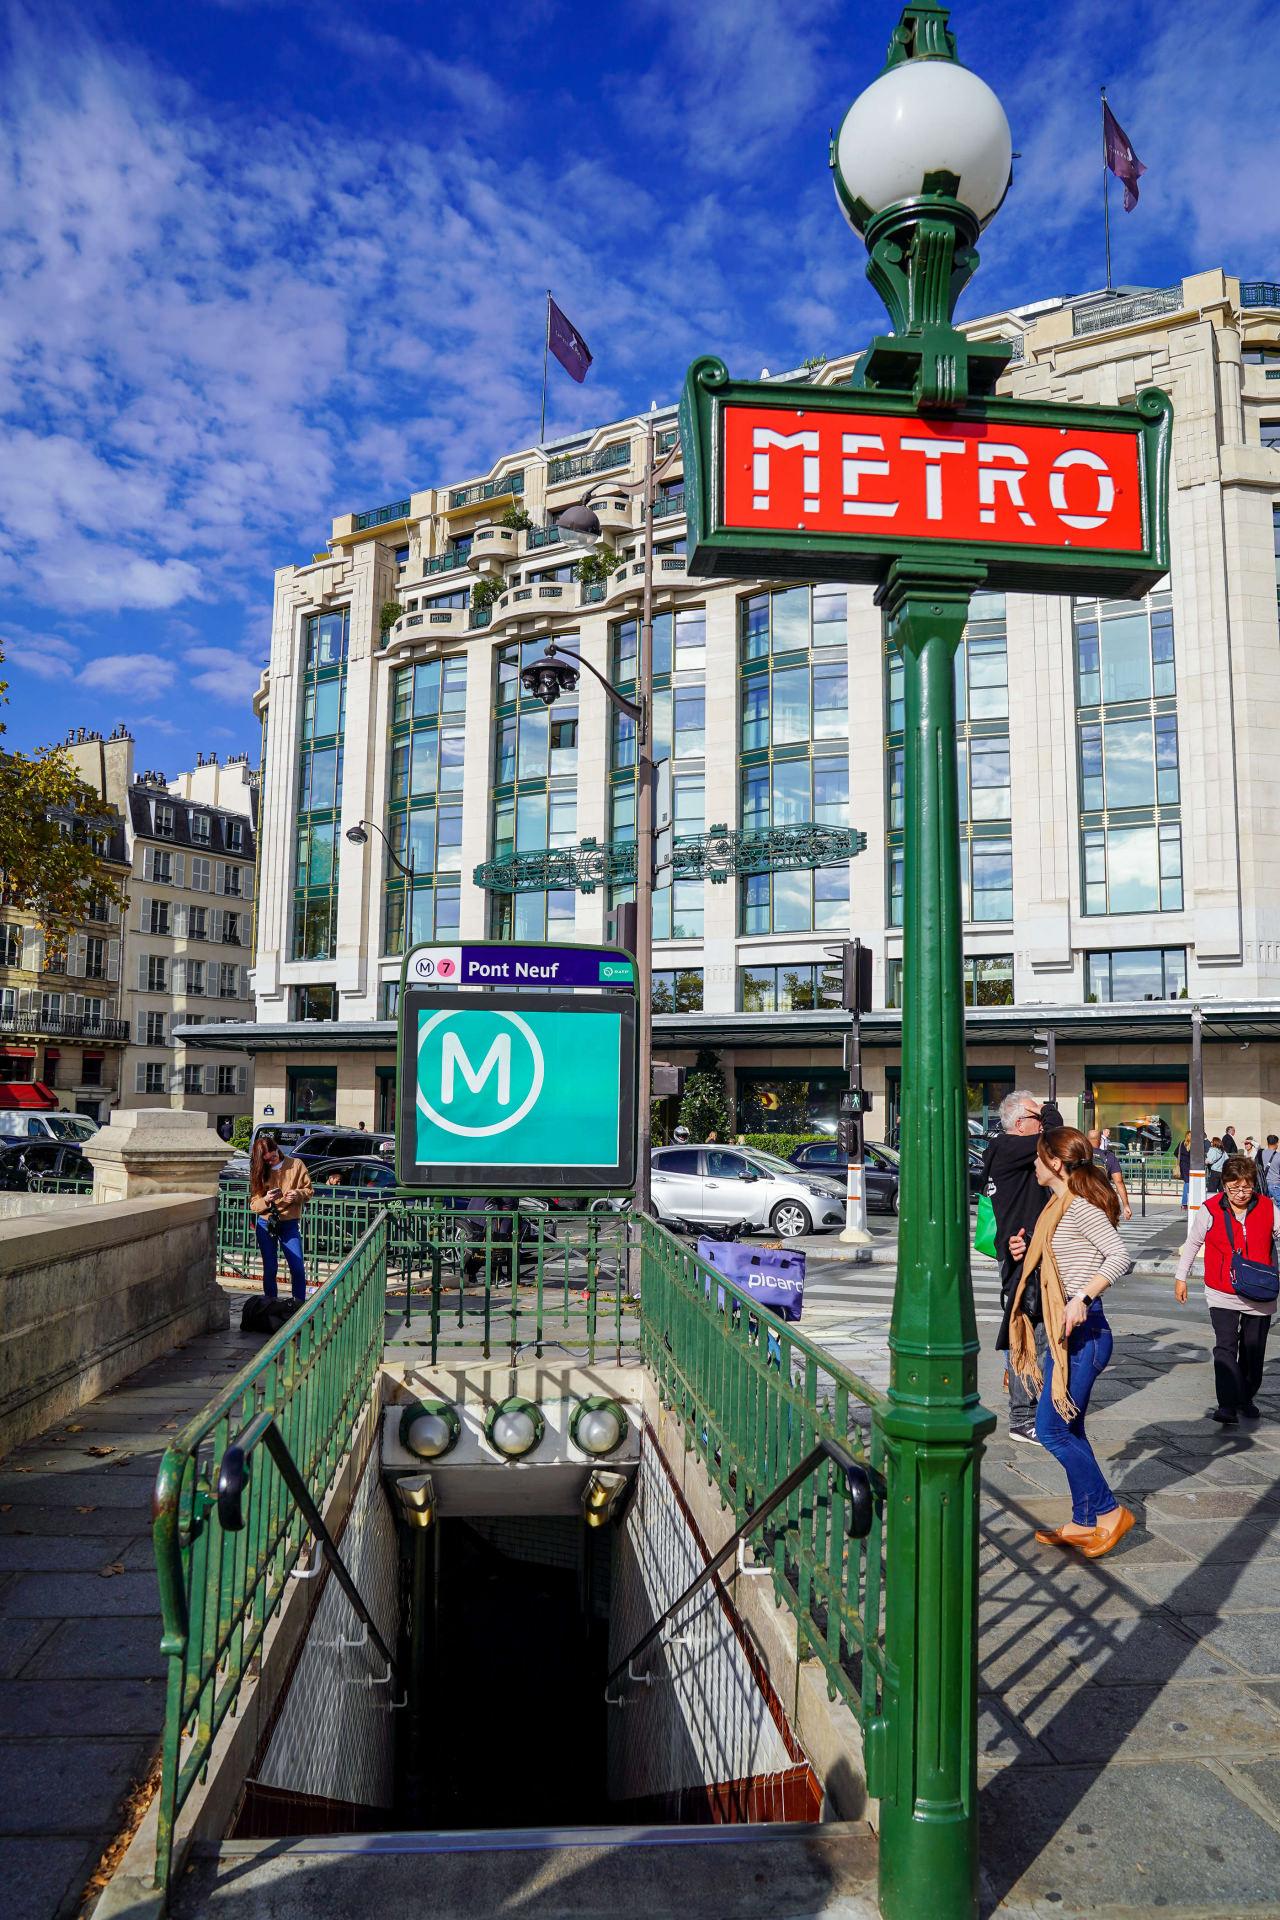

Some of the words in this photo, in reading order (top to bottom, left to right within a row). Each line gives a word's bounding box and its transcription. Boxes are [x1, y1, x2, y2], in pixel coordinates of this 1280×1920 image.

[752, 426, 1115, 530] METRO
[419, 962, 431, 973] M
[442, 962, 451, 974] 7
[468, 961, 510, 978] Pont
[515, 962, 560, 978] Neuf
[440, 1031, 512, 1106] M
